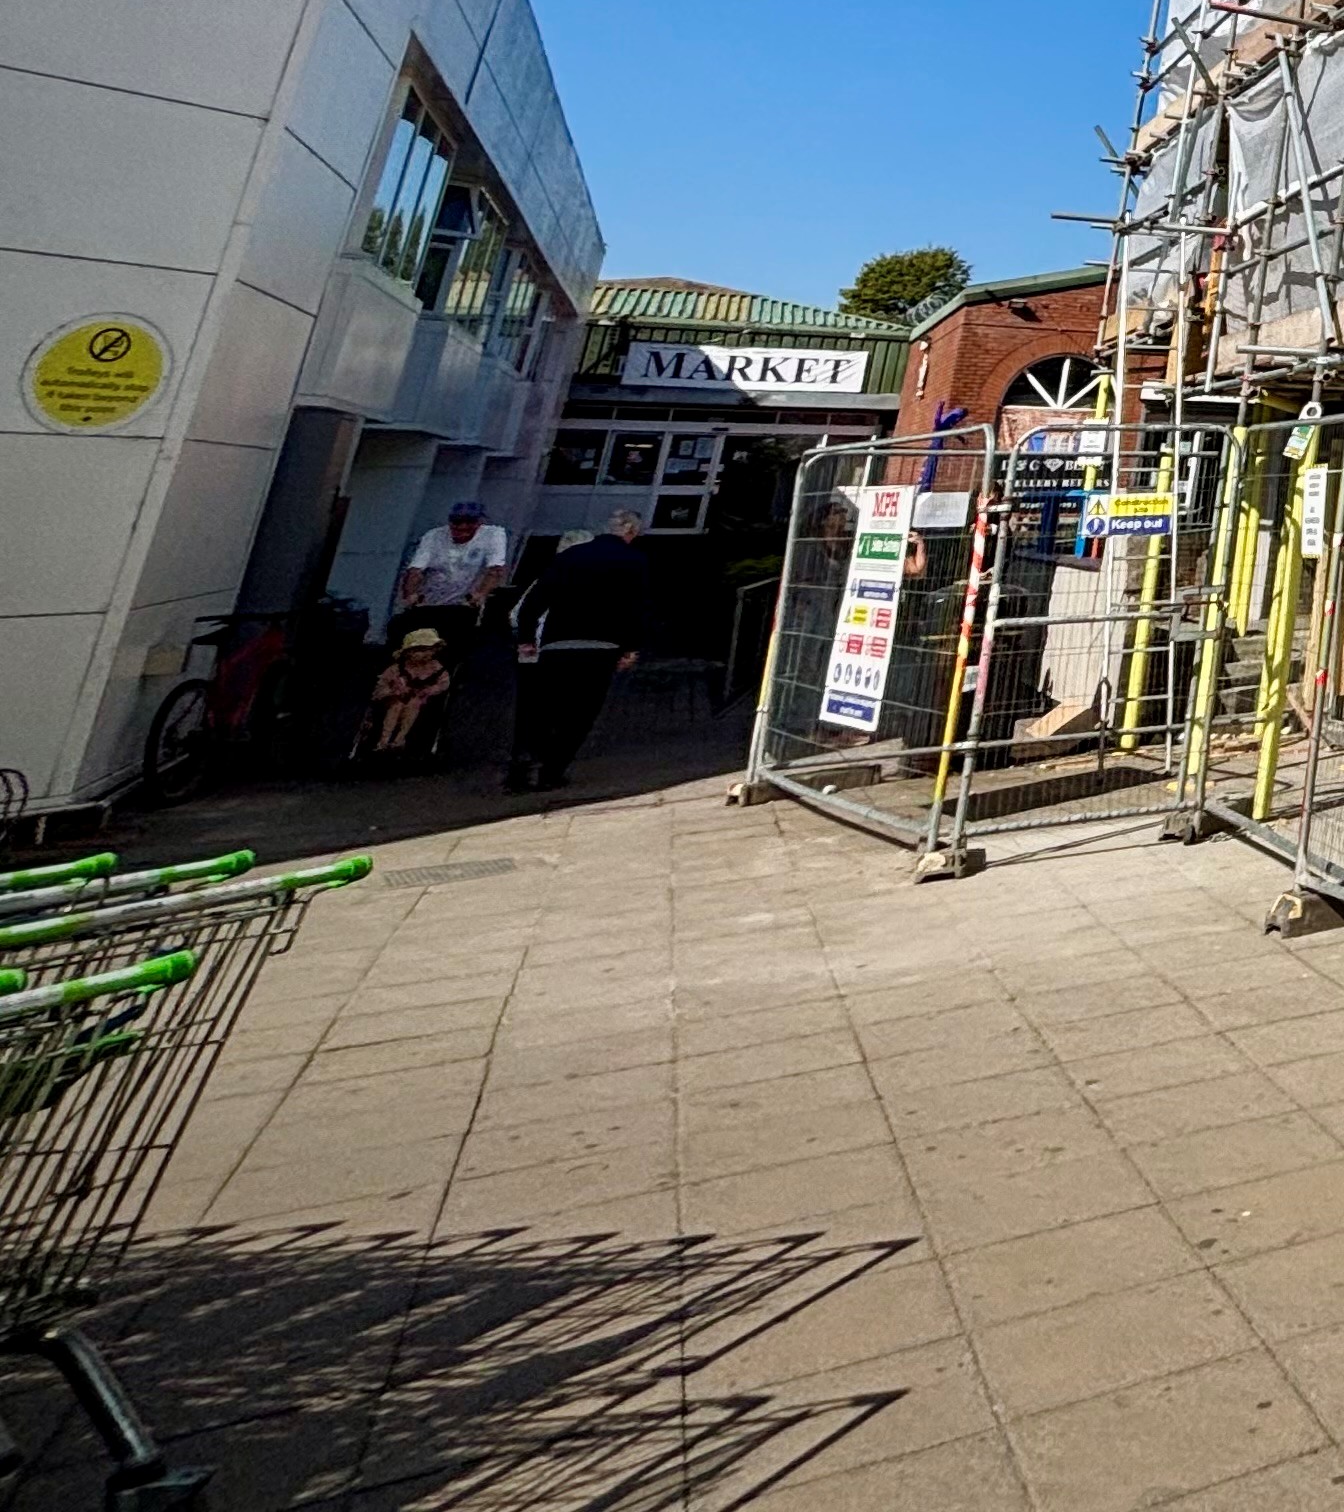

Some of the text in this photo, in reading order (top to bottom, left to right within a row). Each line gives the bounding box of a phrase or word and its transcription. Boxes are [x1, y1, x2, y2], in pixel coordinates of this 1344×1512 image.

[642, 349, 852, 384] MARKET
[1061, 479, 1110, 488] REPRS
[872, 491, 900, 518] MPH
[1111, 518, 1163, 531] Keep out
